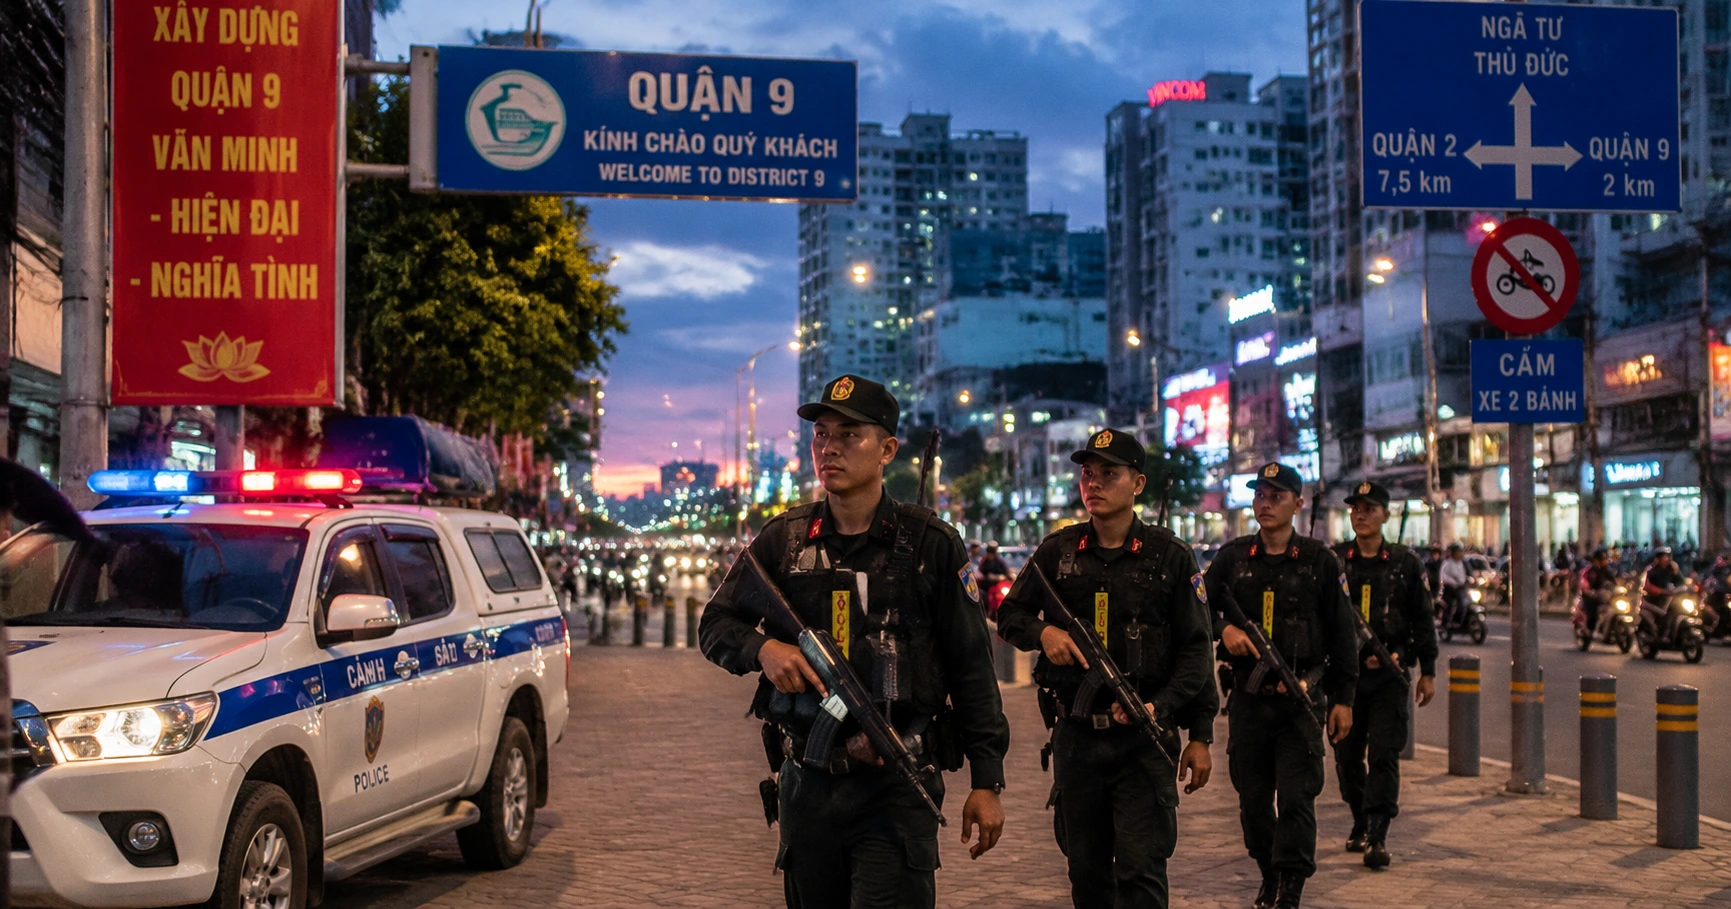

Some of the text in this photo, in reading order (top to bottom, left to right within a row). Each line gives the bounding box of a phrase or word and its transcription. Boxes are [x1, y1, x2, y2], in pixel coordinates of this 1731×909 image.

[153, 0, 299, 53] XÂY DỰNG
[1535, 17, 1564, 40] TƯ
[171, 65, 281, 115] QUẬN 9
[628, 65, 795, 121] QUẬN 9
[221, 136, 298, 173] MINH
[584, 125, 838, 158] KÍNH CHÀO QUÝ KHÁCH
[1372, 127, 1458, 163] QUẬN 2
[1589, 131, 1670, 167] QUẬN 9
[598, 163, 825, 187] WELCOME TO DISTRICT 9
[1377, 169, 1452, 197] 7,5 km
[1603, 173, 1655, 197] 2 km
[171, 191, 240, 242] HIỆN
[249, 199, 300, 244] ĐẠI
[151, 255, 242, 299] NGHĨA
[250, 255, 318, 300] TÌNH
[1478, 390, 1502, 412] XE
[1508, 390, 1519, 412] 2
[353, 764, 390, 794] POLICE
